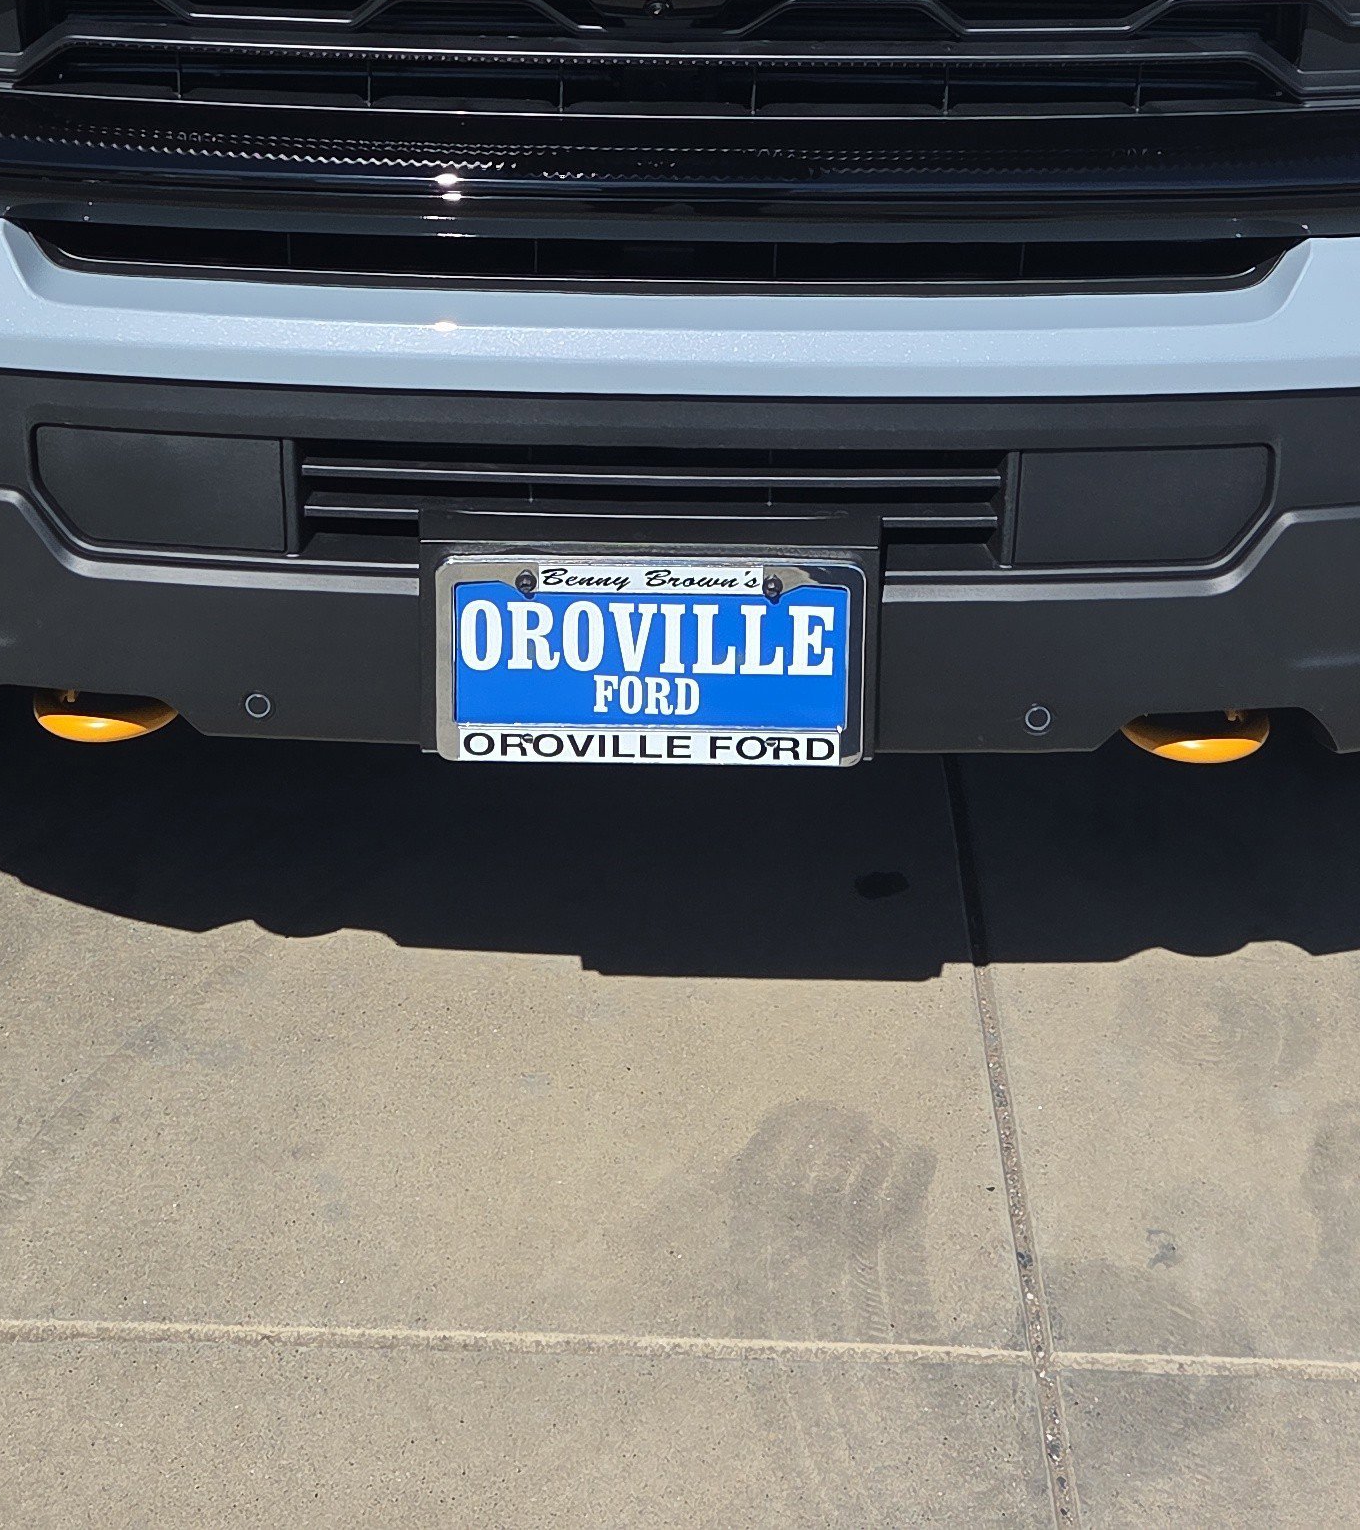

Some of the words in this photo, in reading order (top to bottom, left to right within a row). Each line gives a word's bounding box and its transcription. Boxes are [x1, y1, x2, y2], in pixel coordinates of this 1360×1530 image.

[542, 568, 631, 591] Benny
[645, 568, 761, 589] Brown's
[459, 599, 835, 676] OROVILLE
[593, 674, 700, 716] FORD
[463, 732, 692, 759] OROVILLE
[709, 735, 837, 761] FORD
